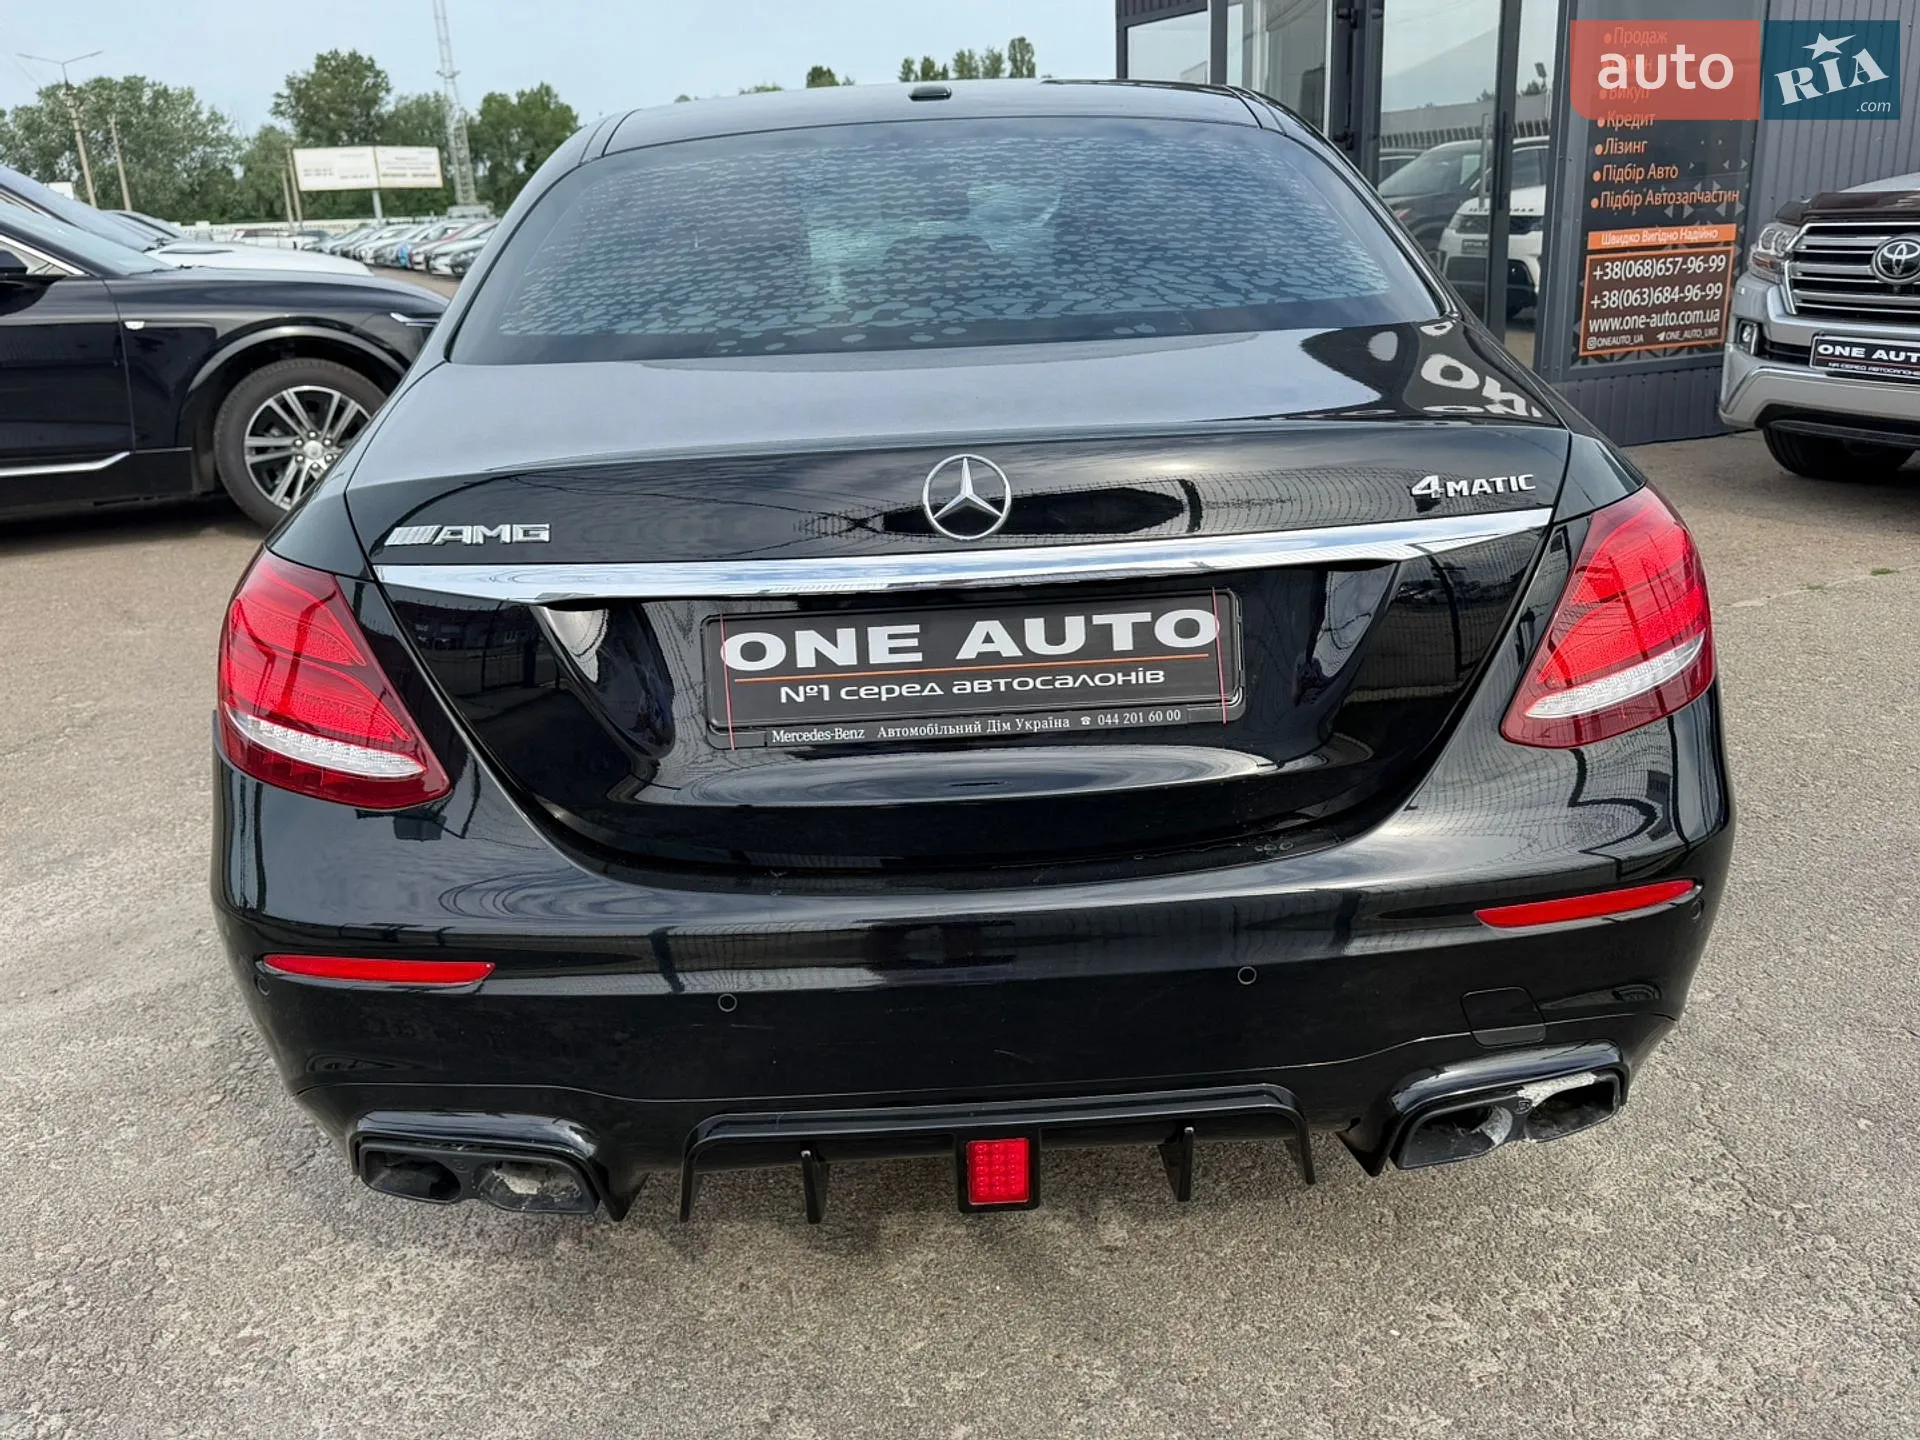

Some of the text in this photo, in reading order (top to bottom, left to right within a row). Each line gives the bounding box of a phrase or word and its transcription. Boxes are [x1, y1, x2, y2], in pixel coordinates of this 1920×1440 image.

[1613, 26, 1668, 47] Продаж
[1607, 110, 1656, 131] Кредит
[1603, 138, 1648, 155] Лізинг
[1602, 163, 1679, 184] Підбір Авто
[1600, 189, 1740, 211] Підбір Автозапчастин
[1592, 254, 1726, 281] +38(068)657-96-99
[1590, 282, 1723, 309] +38(063)684-96-99
[1589, 309, 1720, 333] www.one-auto.com.ua
[1817, 344, 1866, 358] ONE
[432, 523, 550, 546] AMG
[720, 609, 1219, 671] ONE AUTO
[840, 682, 945, 702] серед
[952, 668, 1166, 695] автосалонів
[772, 709, 1181, 743] Mercedes-Benz Автомобільний Дім Україна 044 201 60 00
